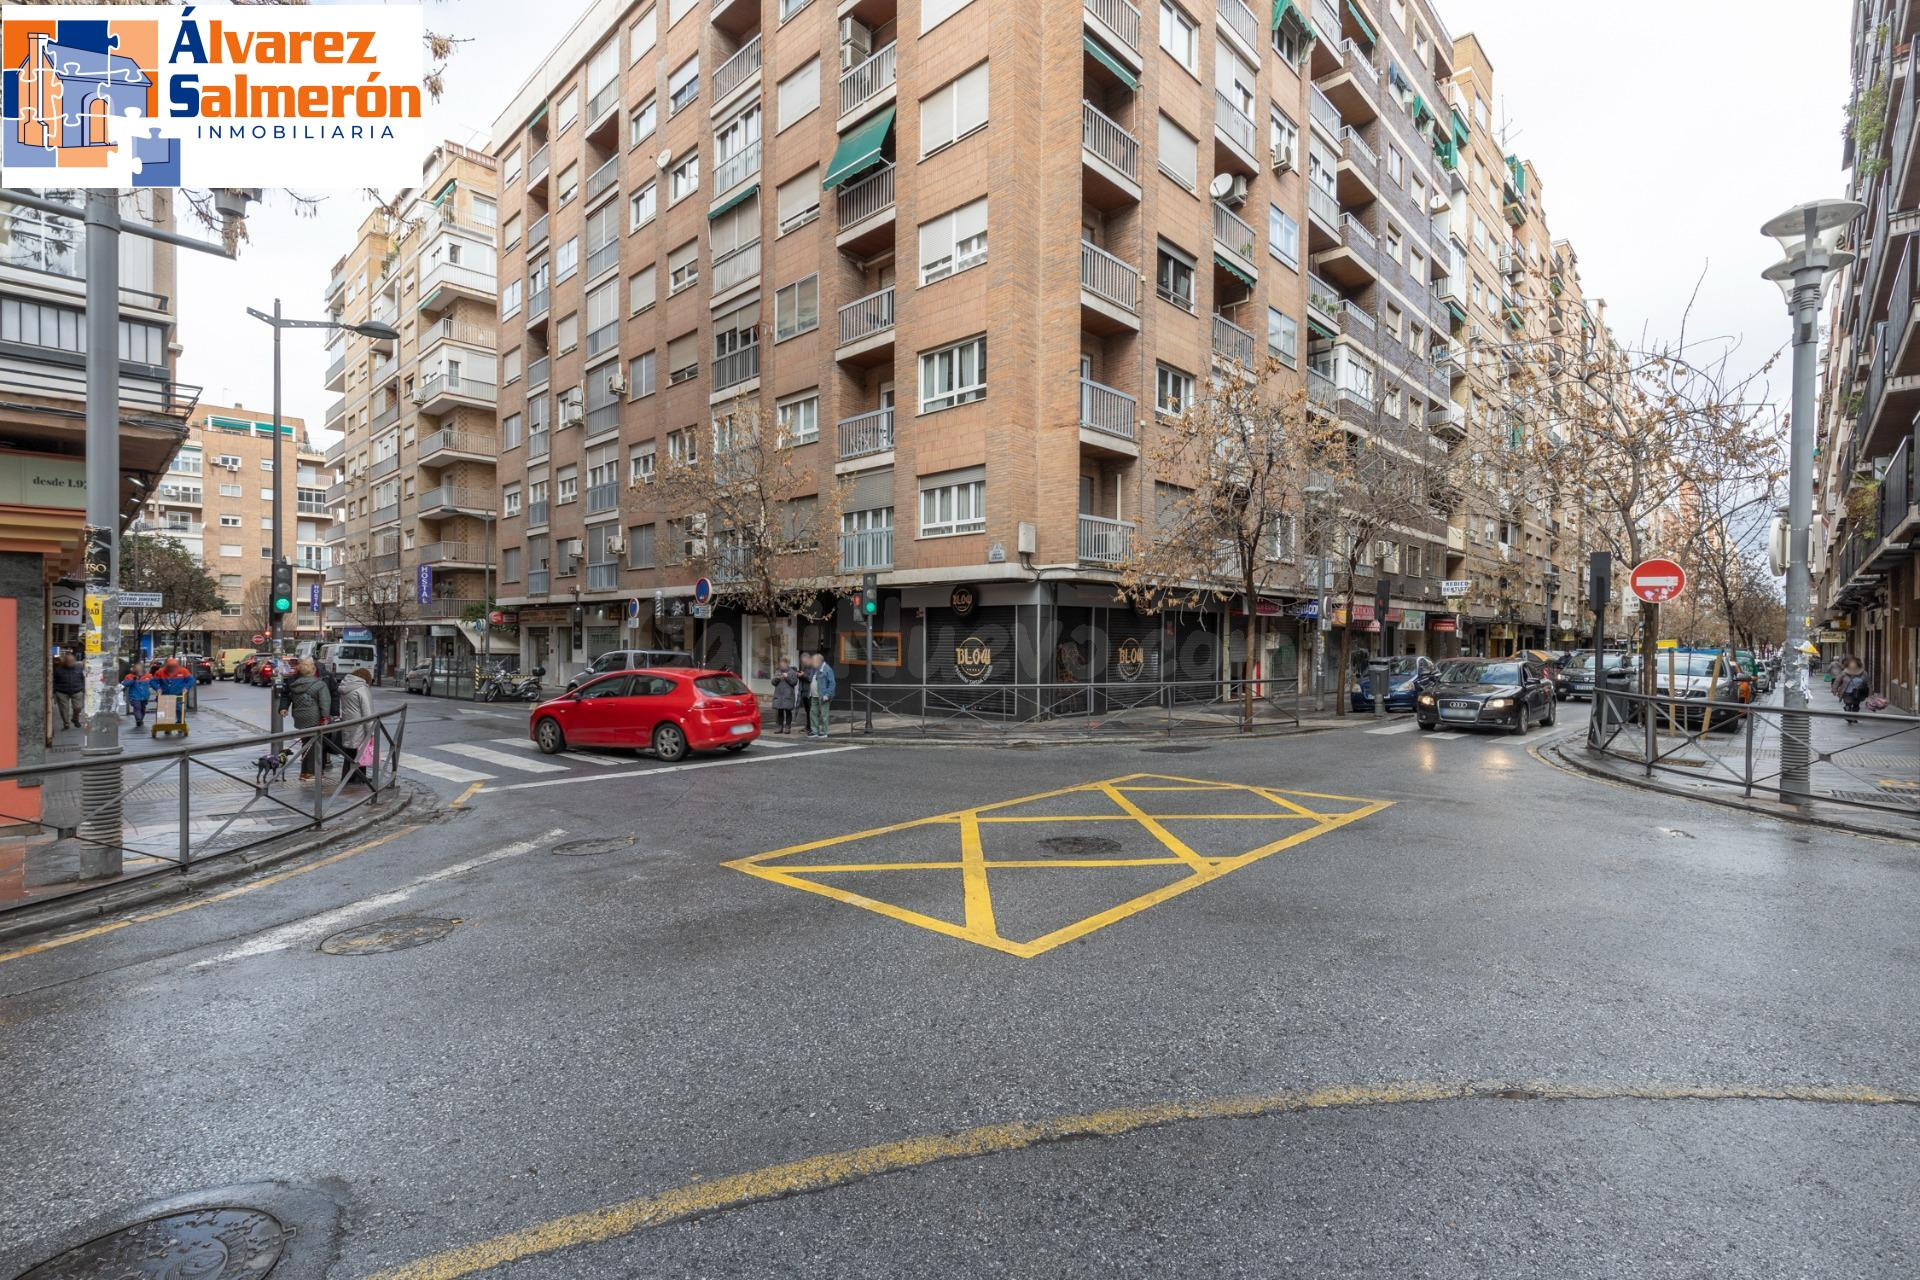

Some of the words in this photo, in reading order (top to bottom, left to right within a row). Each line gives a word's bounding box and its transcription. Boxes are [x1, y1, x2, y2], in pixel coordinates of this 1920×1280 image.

[33, 476, 65, 487] desde
[420, 566, 428, 604] HOSTAL
[953, 594, 973, 605] BLOW
[955, 647, 992, 665] BLOW
[1118, 647, 1144, 664] BLOW
